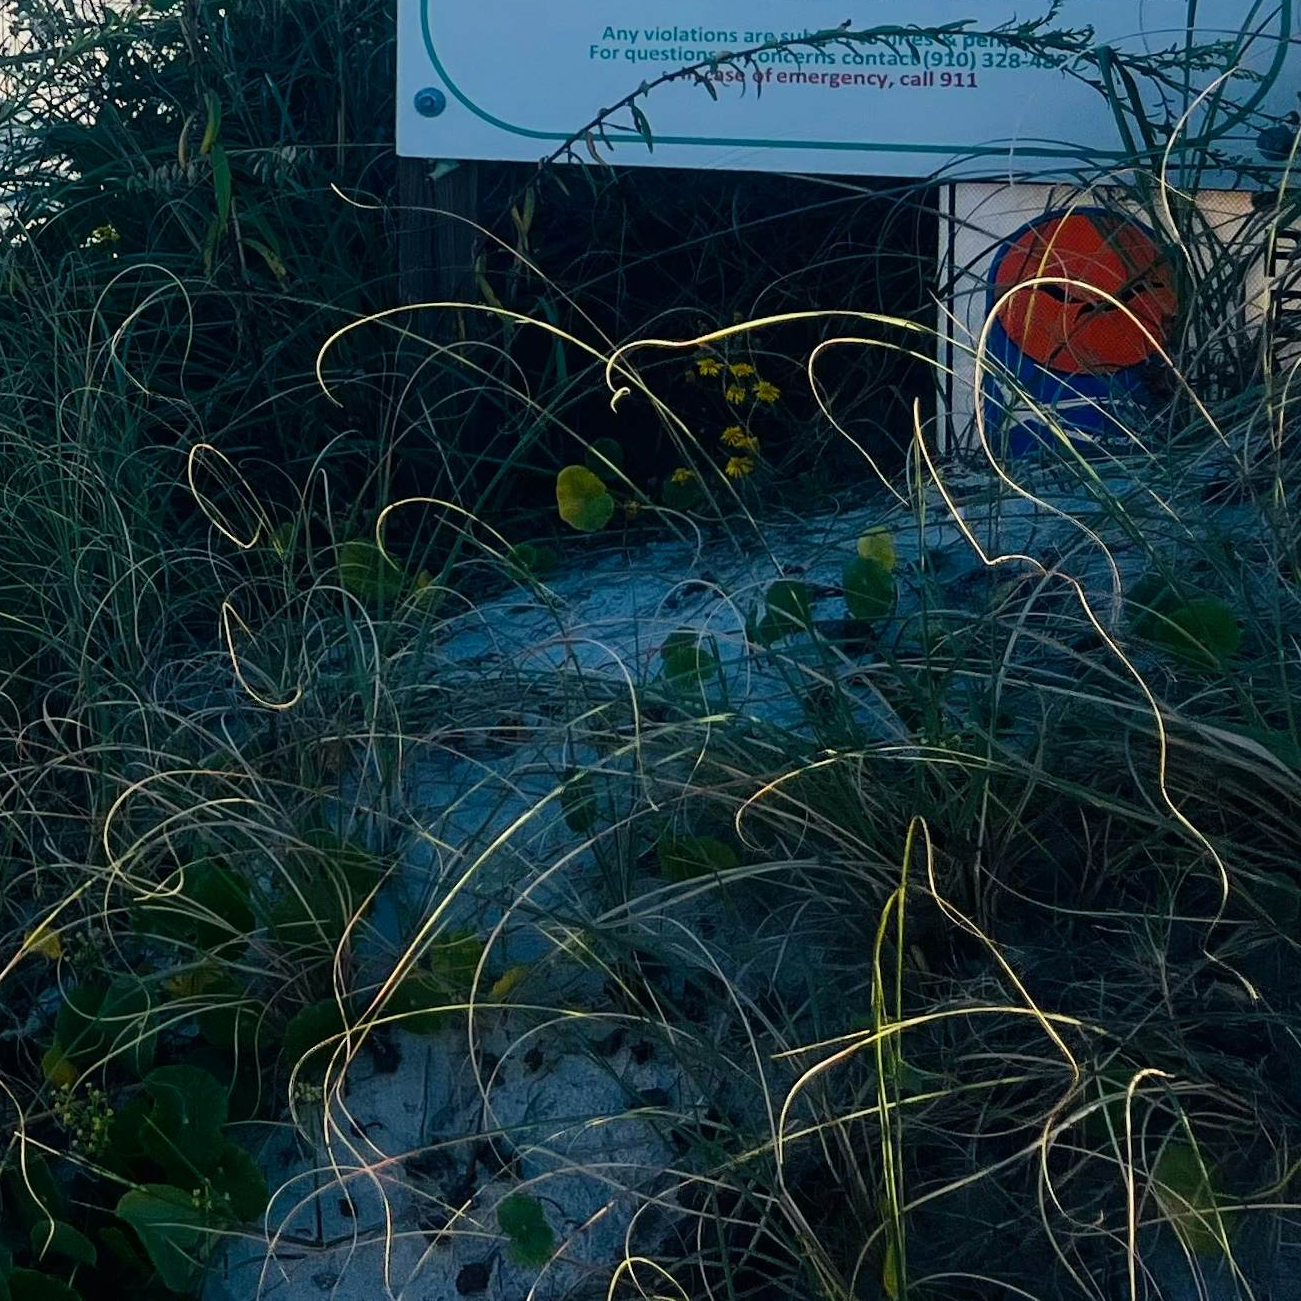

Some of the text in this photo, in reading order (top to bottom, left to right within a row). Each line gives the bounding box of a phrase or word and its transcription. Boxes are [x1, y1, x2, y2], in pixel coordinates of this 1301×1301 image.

[601, 26, 639, 44] Any
[644, 26, 738, 43] violations
[743, 30, 775, 43] are
[589, 45, 619, 60] For
[841, 51, 919, 66] contact
[923, 50, 977, 70] (910)
[776, 71, 895, 89] emergency,
[900, 71, 935, 87] call
[939, 72, 979, 88] 911
